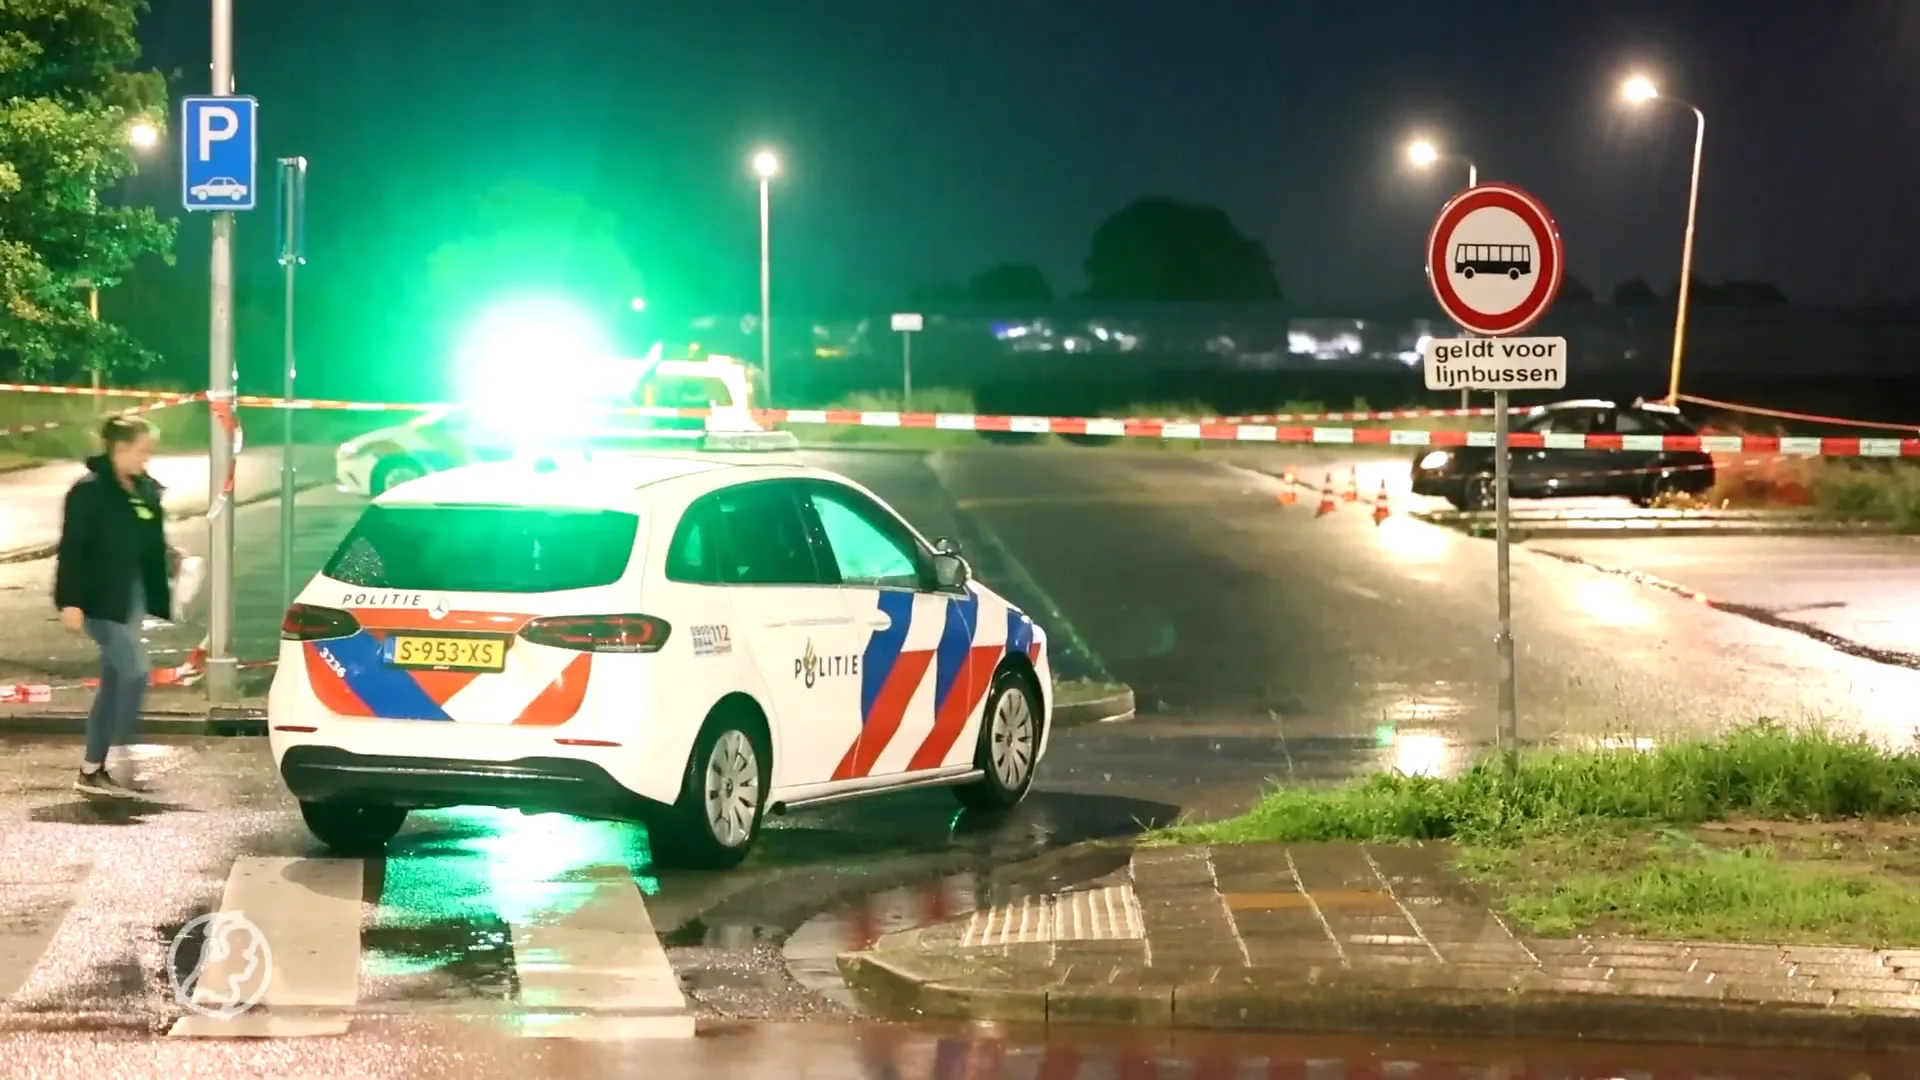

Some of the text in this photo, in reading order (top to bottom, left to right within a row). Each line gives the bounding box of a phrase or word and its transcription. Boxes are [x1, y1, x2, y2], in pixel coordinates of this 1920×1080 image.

[199, 106, 238, 161] P
[1435, 341, 1557, 363] geldt voor
[1436, 365, 1558, 387] lijnbussen
[341, 593, 422, 606] POLITIE
[710, 624, 731, 642] 112
[319, 647, 346, 678] 3236
[400, 640, 493, 664] S-953-XS
[794, 654, 859, 689] POLITIE
